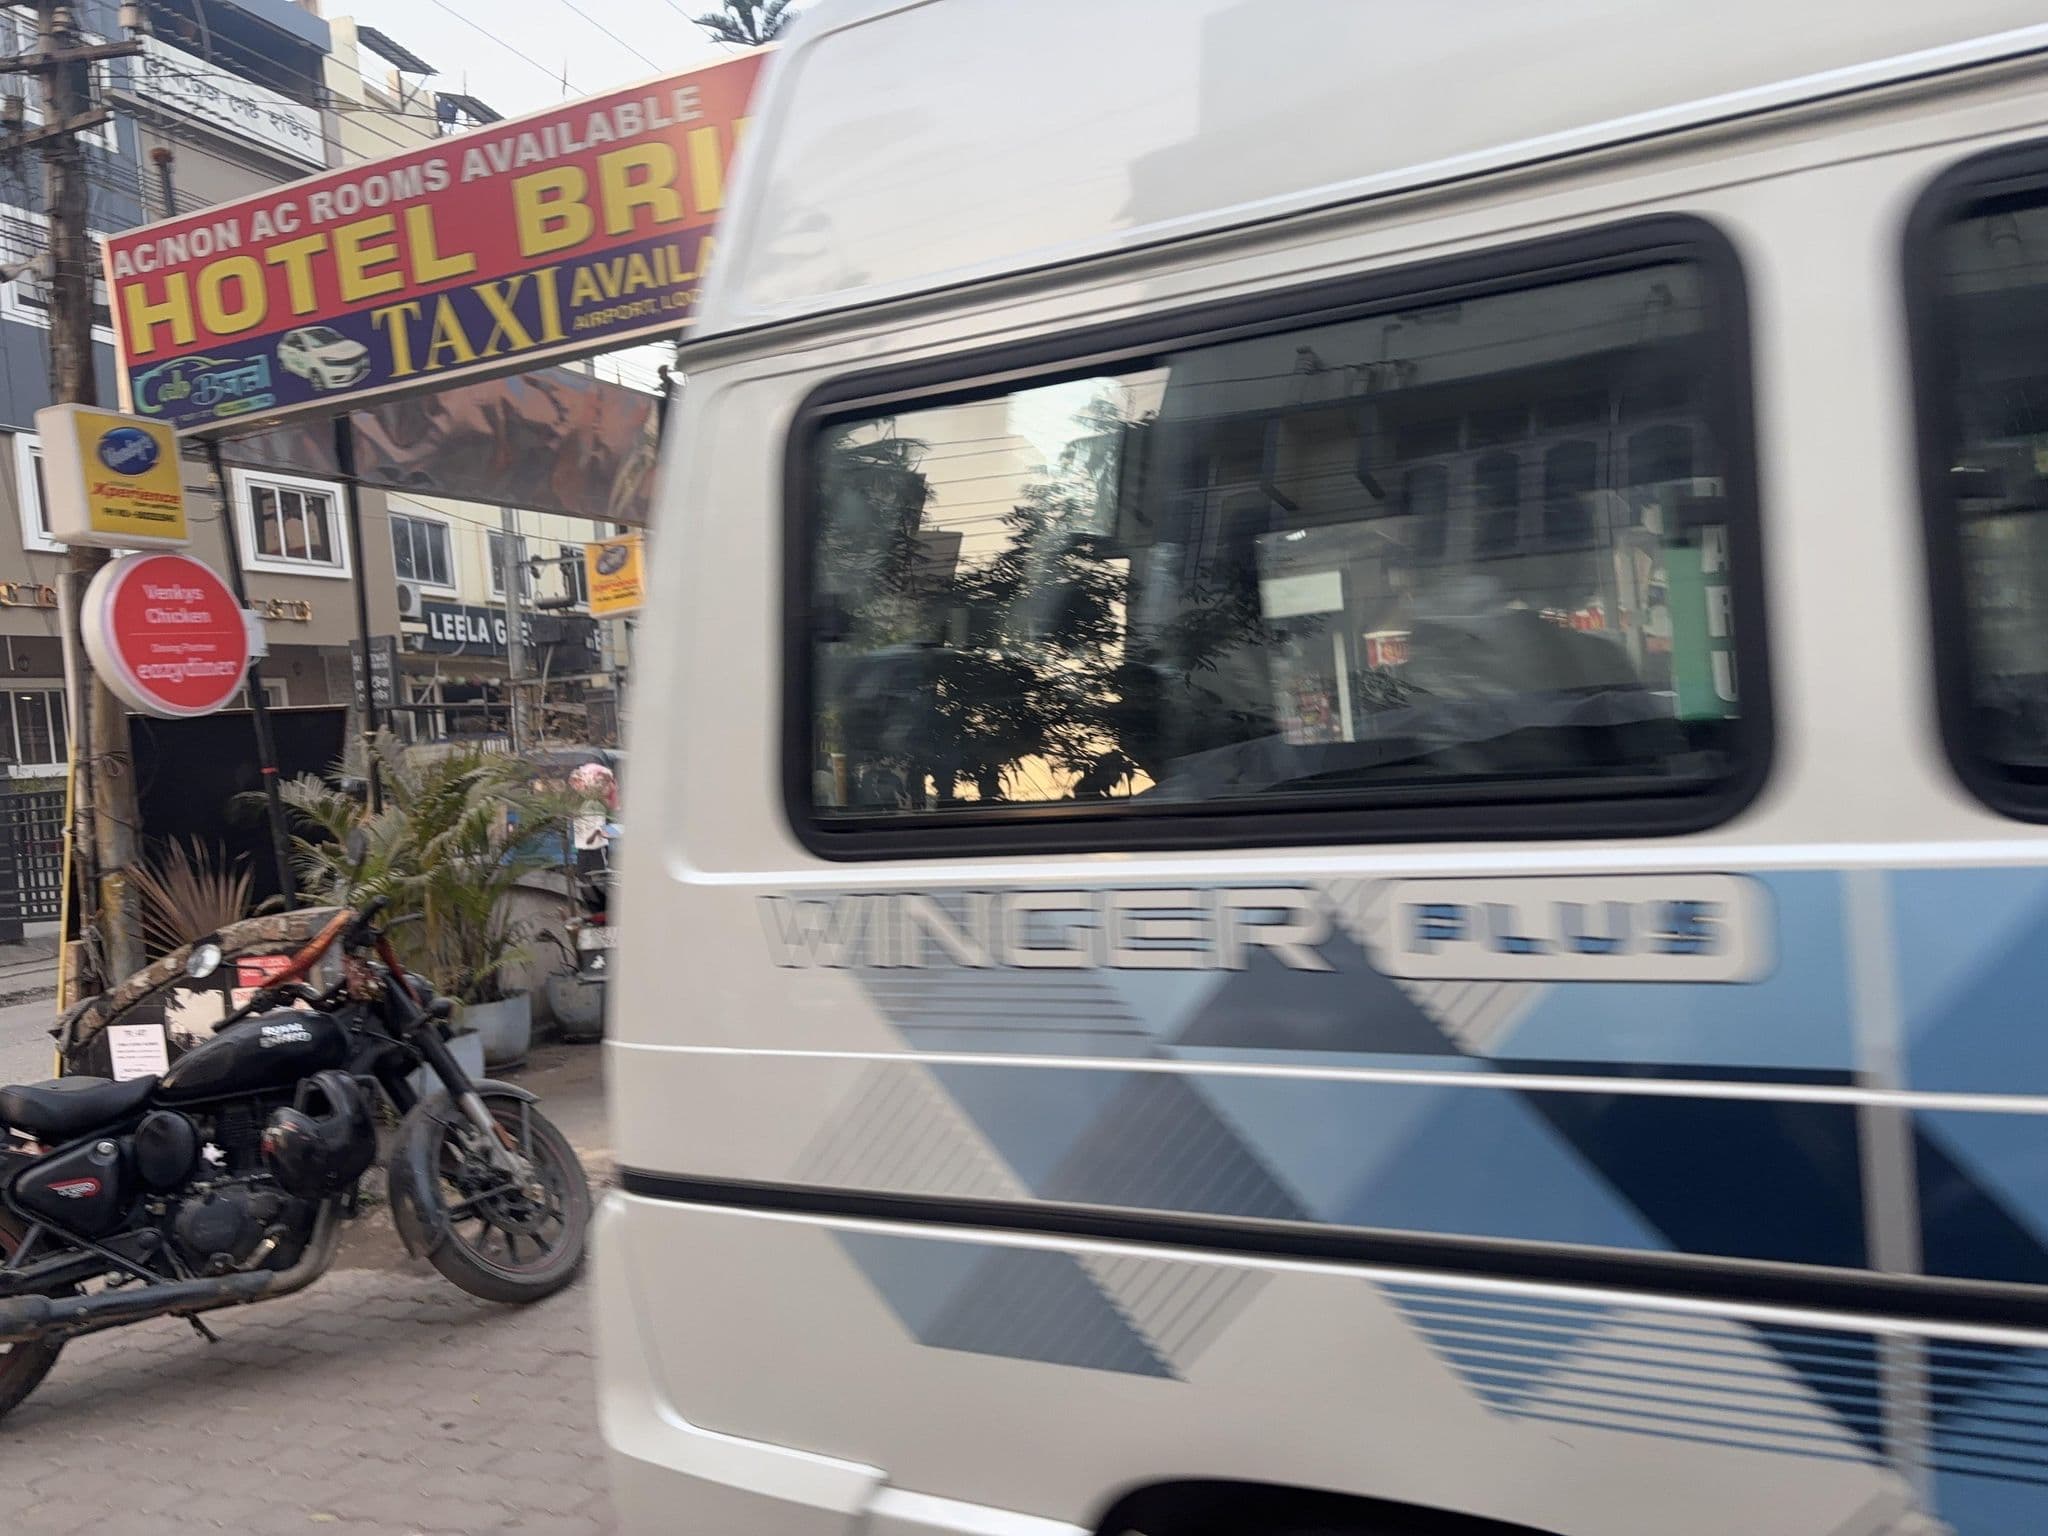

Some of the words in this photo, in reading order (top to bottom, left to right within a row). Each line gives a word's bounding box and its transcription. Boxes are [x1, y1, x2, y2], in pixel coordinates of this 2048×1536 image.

[114, 218, 241, 279] AC/NON
[250, 202, 301, 242] AC
[307, 158, 450, 224] ROOMS
[461, 85, 704, 182] AVAILABLE
[123, 203, 477, 355] HOTEL
[512, 118, 751, 258] BRI
[371, 266, 571, 377] TAXI
[145, 607, 212, 624] Chicken
[430, 611, 491, 643] LEELA
[758, 886, 1340, 973] WINGER
[1401, 898, 1728, 956] PLUS
